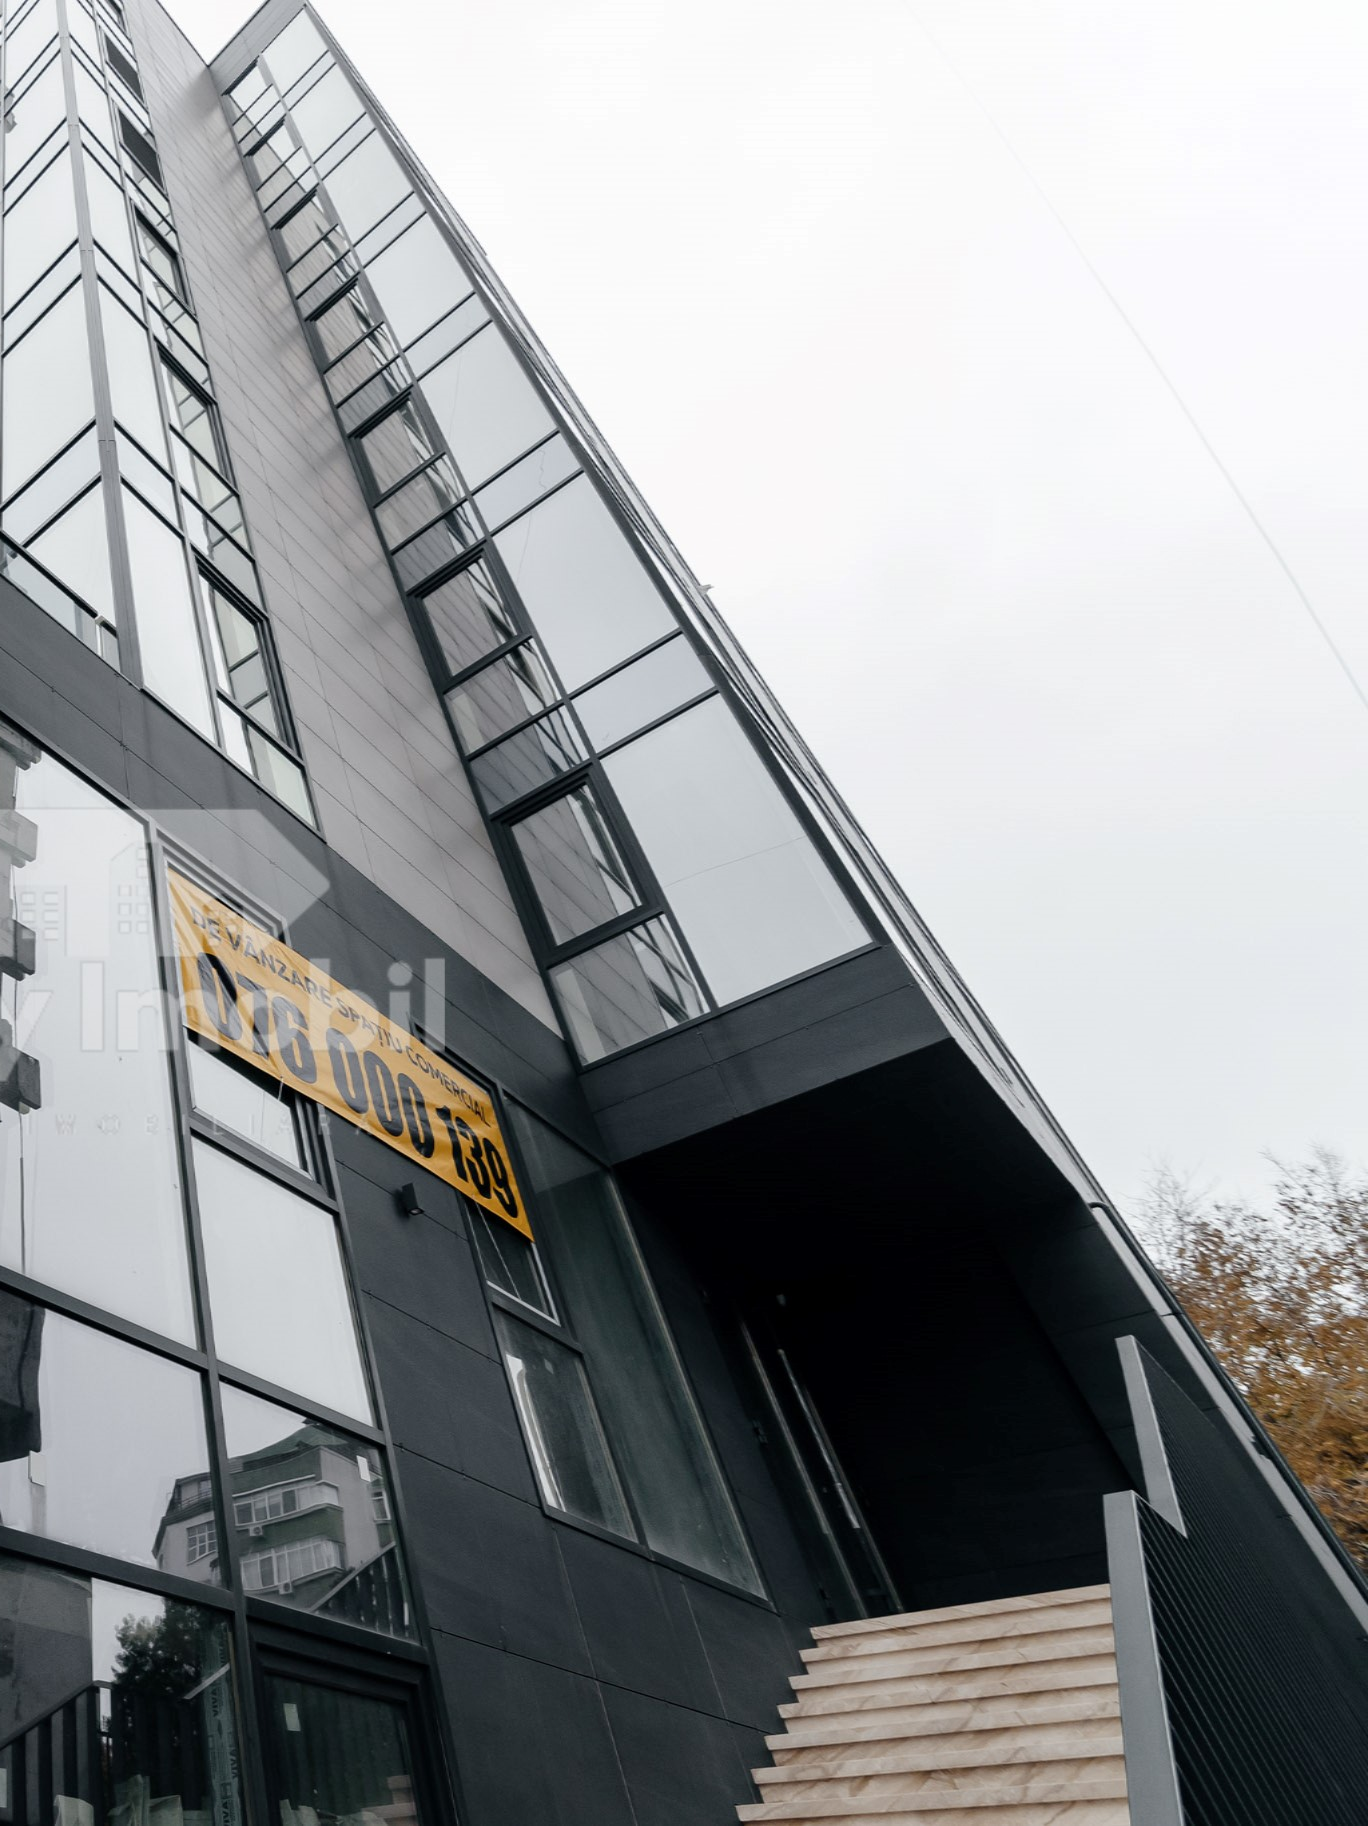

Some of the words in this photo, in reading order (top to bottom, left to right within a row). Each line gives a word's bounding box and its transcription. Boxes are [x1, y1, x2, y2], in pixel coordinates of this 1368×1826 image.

[190, 906, 222, 943] DE
[225, 927, 333, 1009] VÂNZARE
[405, 1045, 492, 1129] COMERCIAL
[196, 952, 318, 1085] 076
[325, 1027, 435, 1160] 000
[435, 1104, 519, 1219] 139
